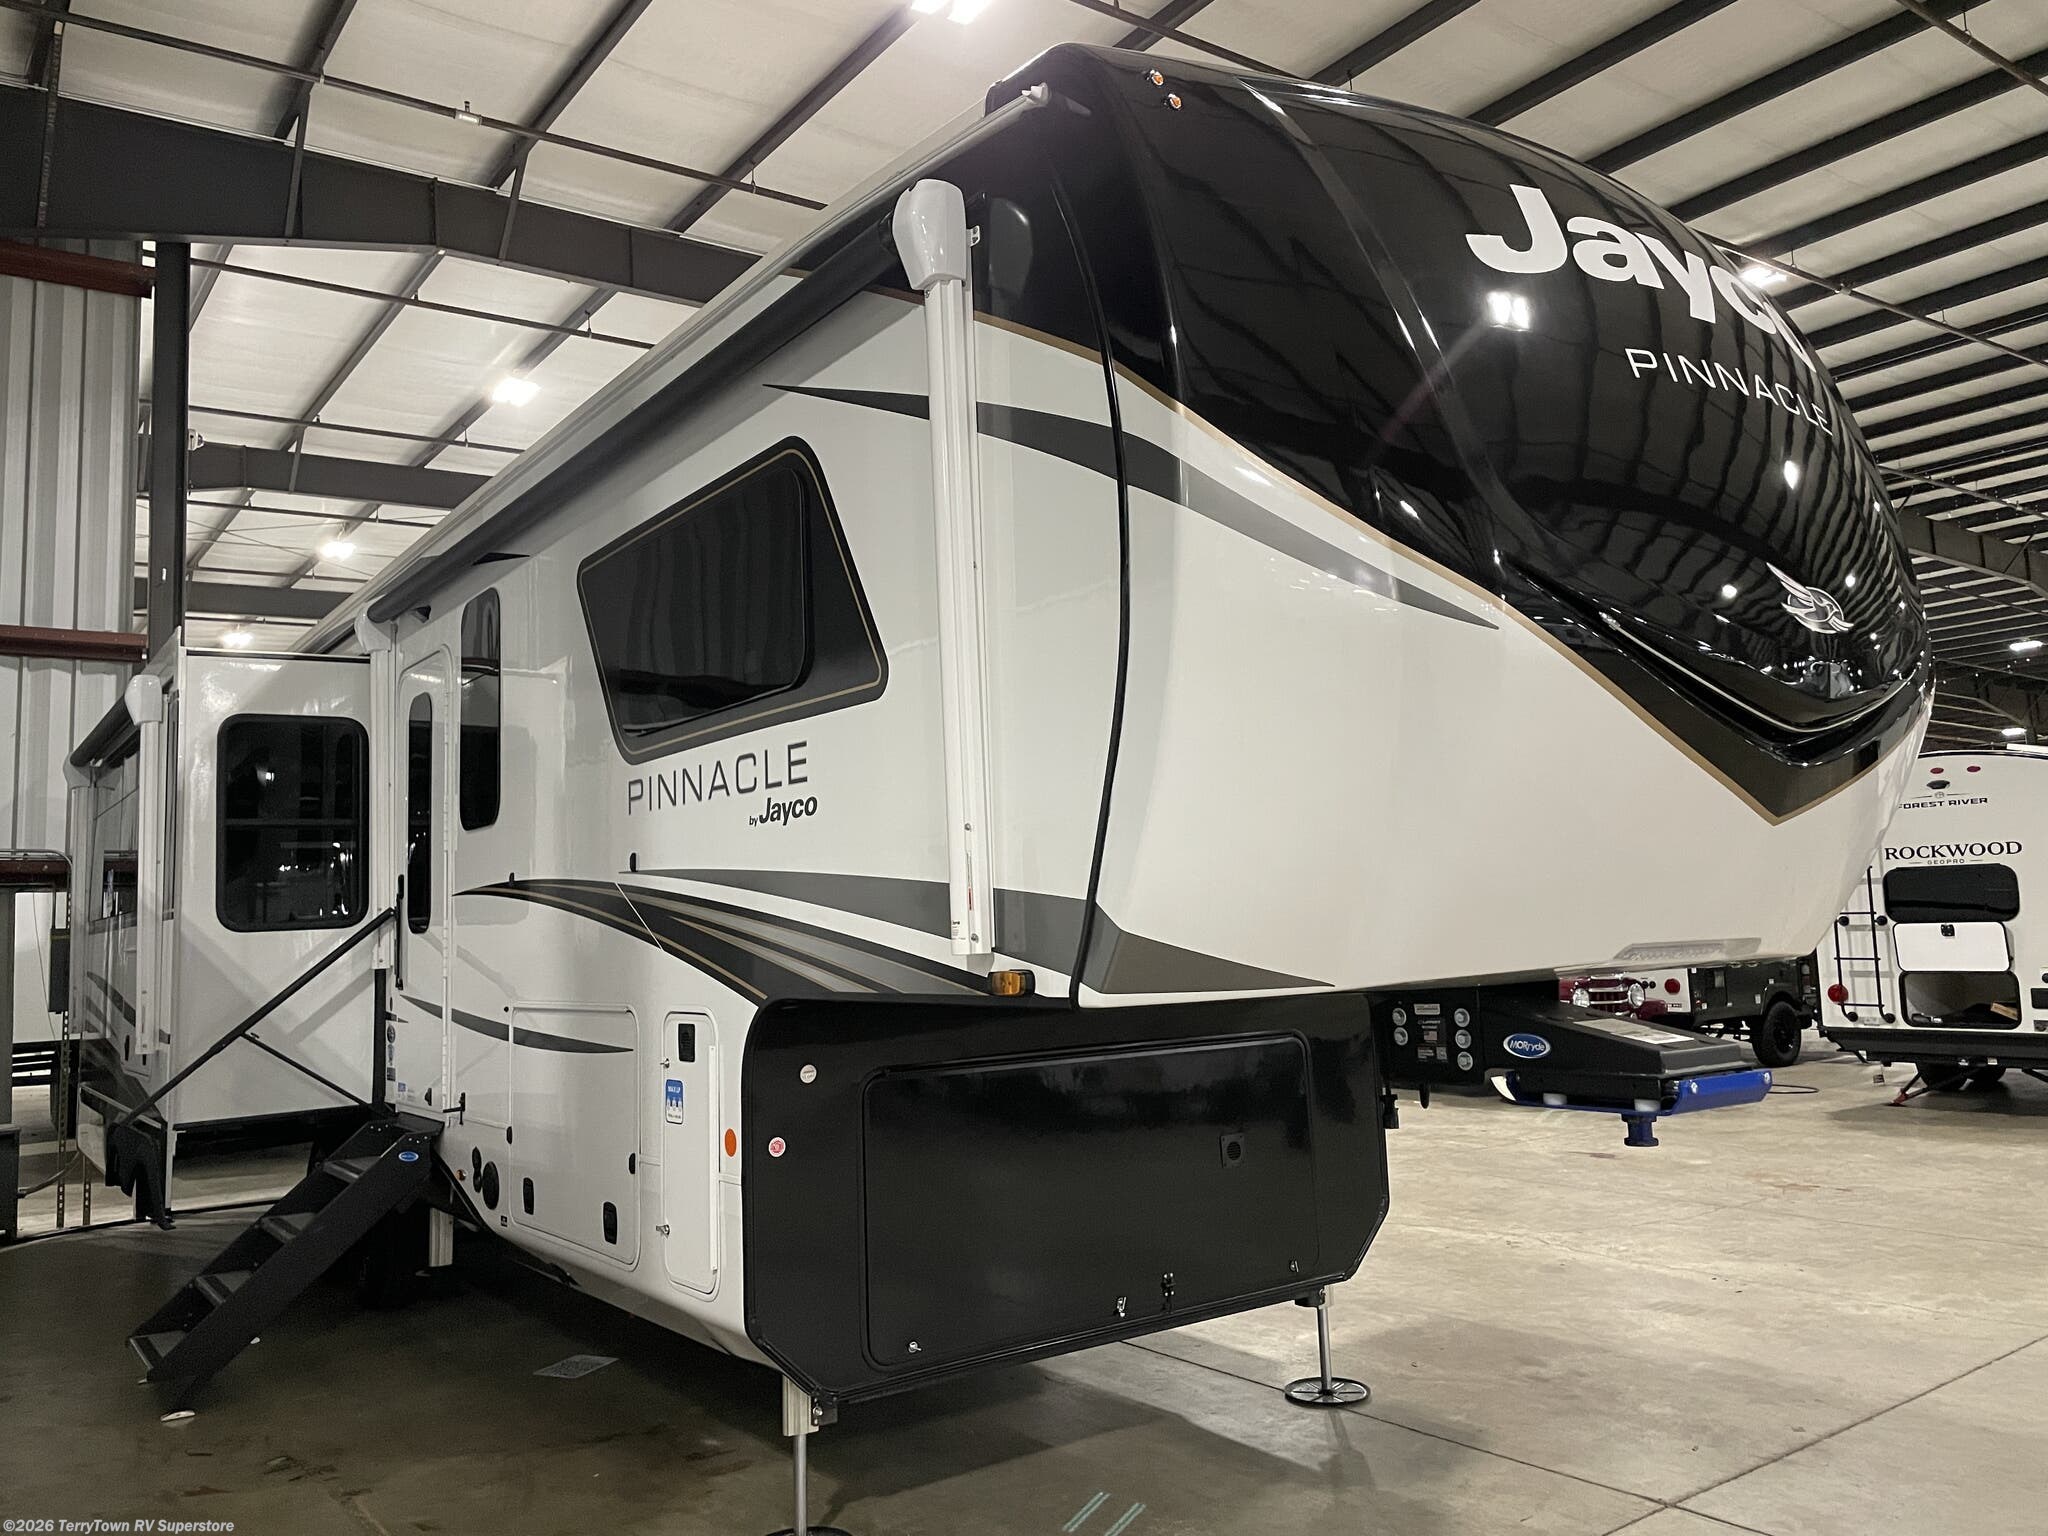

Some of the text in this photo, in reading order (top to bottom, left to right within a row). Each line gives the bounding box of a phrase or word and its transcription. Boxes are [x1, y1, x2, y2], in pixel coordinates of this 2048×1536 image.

[1625, 347, 1834, 437] PINNACLE
[628, 740, 808, 816] PINNACLE
[749, 796, 818, 828] by Jayco
[1948, 797, 1988, 807] RIVER
[1884, 841, 2023, 861] ROCKWOOD
[1510, 1040, 1545, 1052] MORryde
